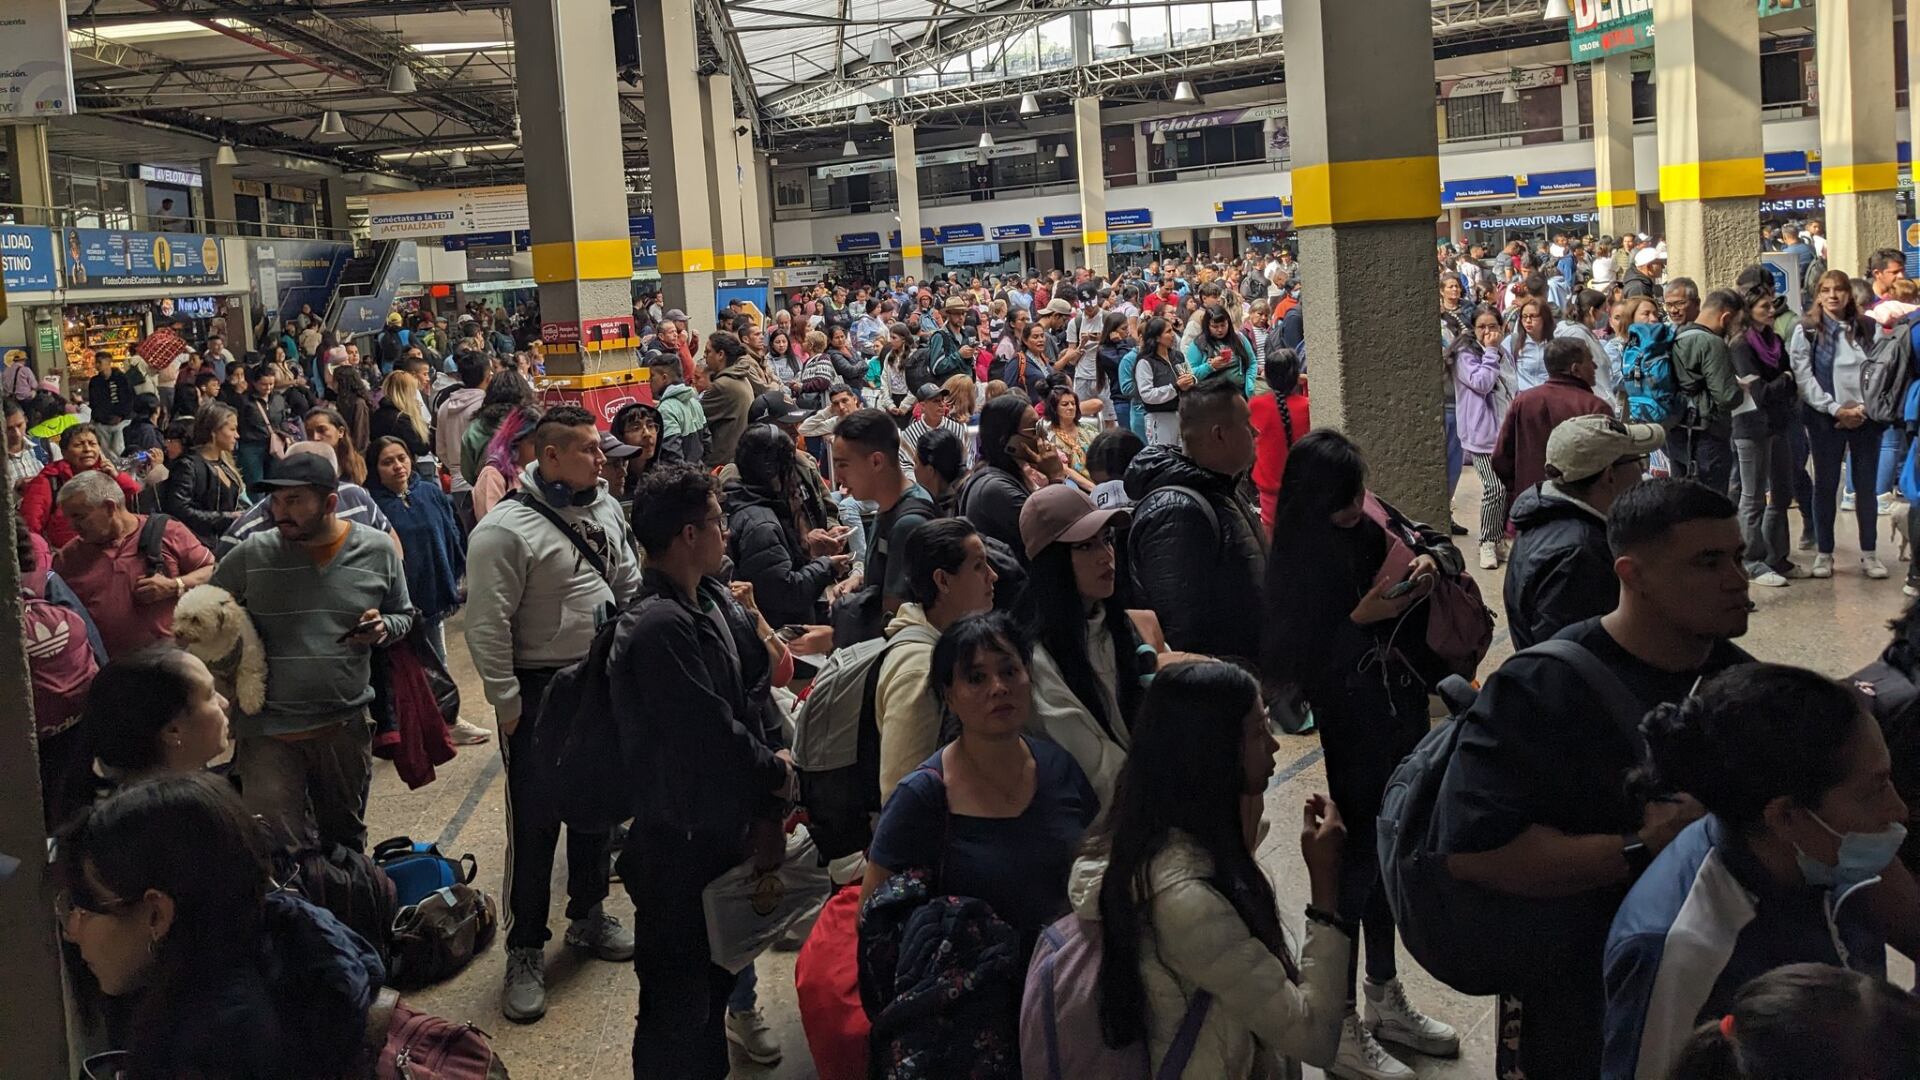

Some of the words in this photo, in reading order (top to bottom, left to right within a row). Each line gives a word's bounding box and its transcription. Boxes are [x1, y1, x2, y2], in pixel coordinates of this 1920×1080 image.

[372, 215, 415, 224] Conéctate
[435, 212, 453, 220] TDT
[1480, 214, 1564, 229] BUENAVENTURA
[0, 234, 34, 252] LIDAD,
